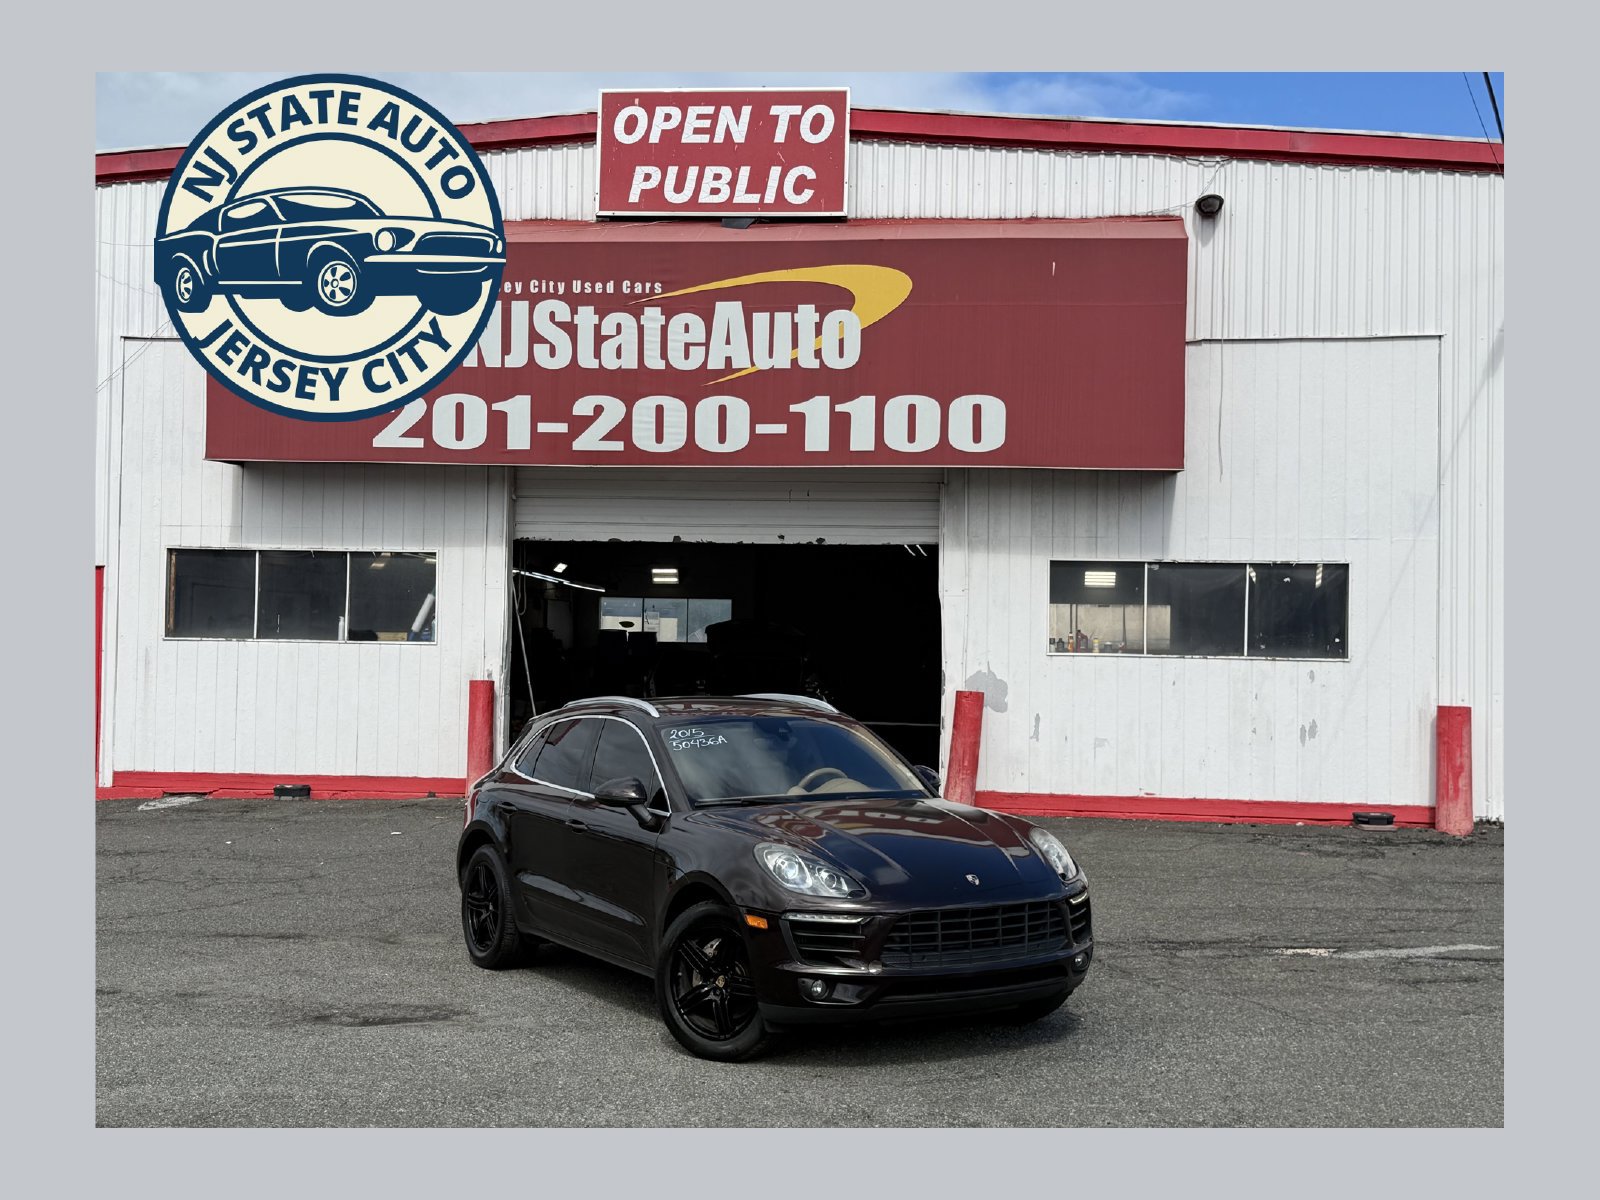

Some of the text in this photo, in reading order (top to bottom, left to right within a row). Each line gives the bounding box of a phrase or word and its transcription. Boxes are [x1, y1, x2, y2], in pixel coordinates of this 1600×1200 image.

[613, 104, 835, 145] OPEN TO
[628, 165, 817, 205] PUBLIC
[529, 279, 565, 295] City
[572, 279, 615, 294] Used
[622, 279, 663, 294] Cars
[372, 393, 1007, 453] 201-200-1100
[669, 728, 705, 740] 2015
